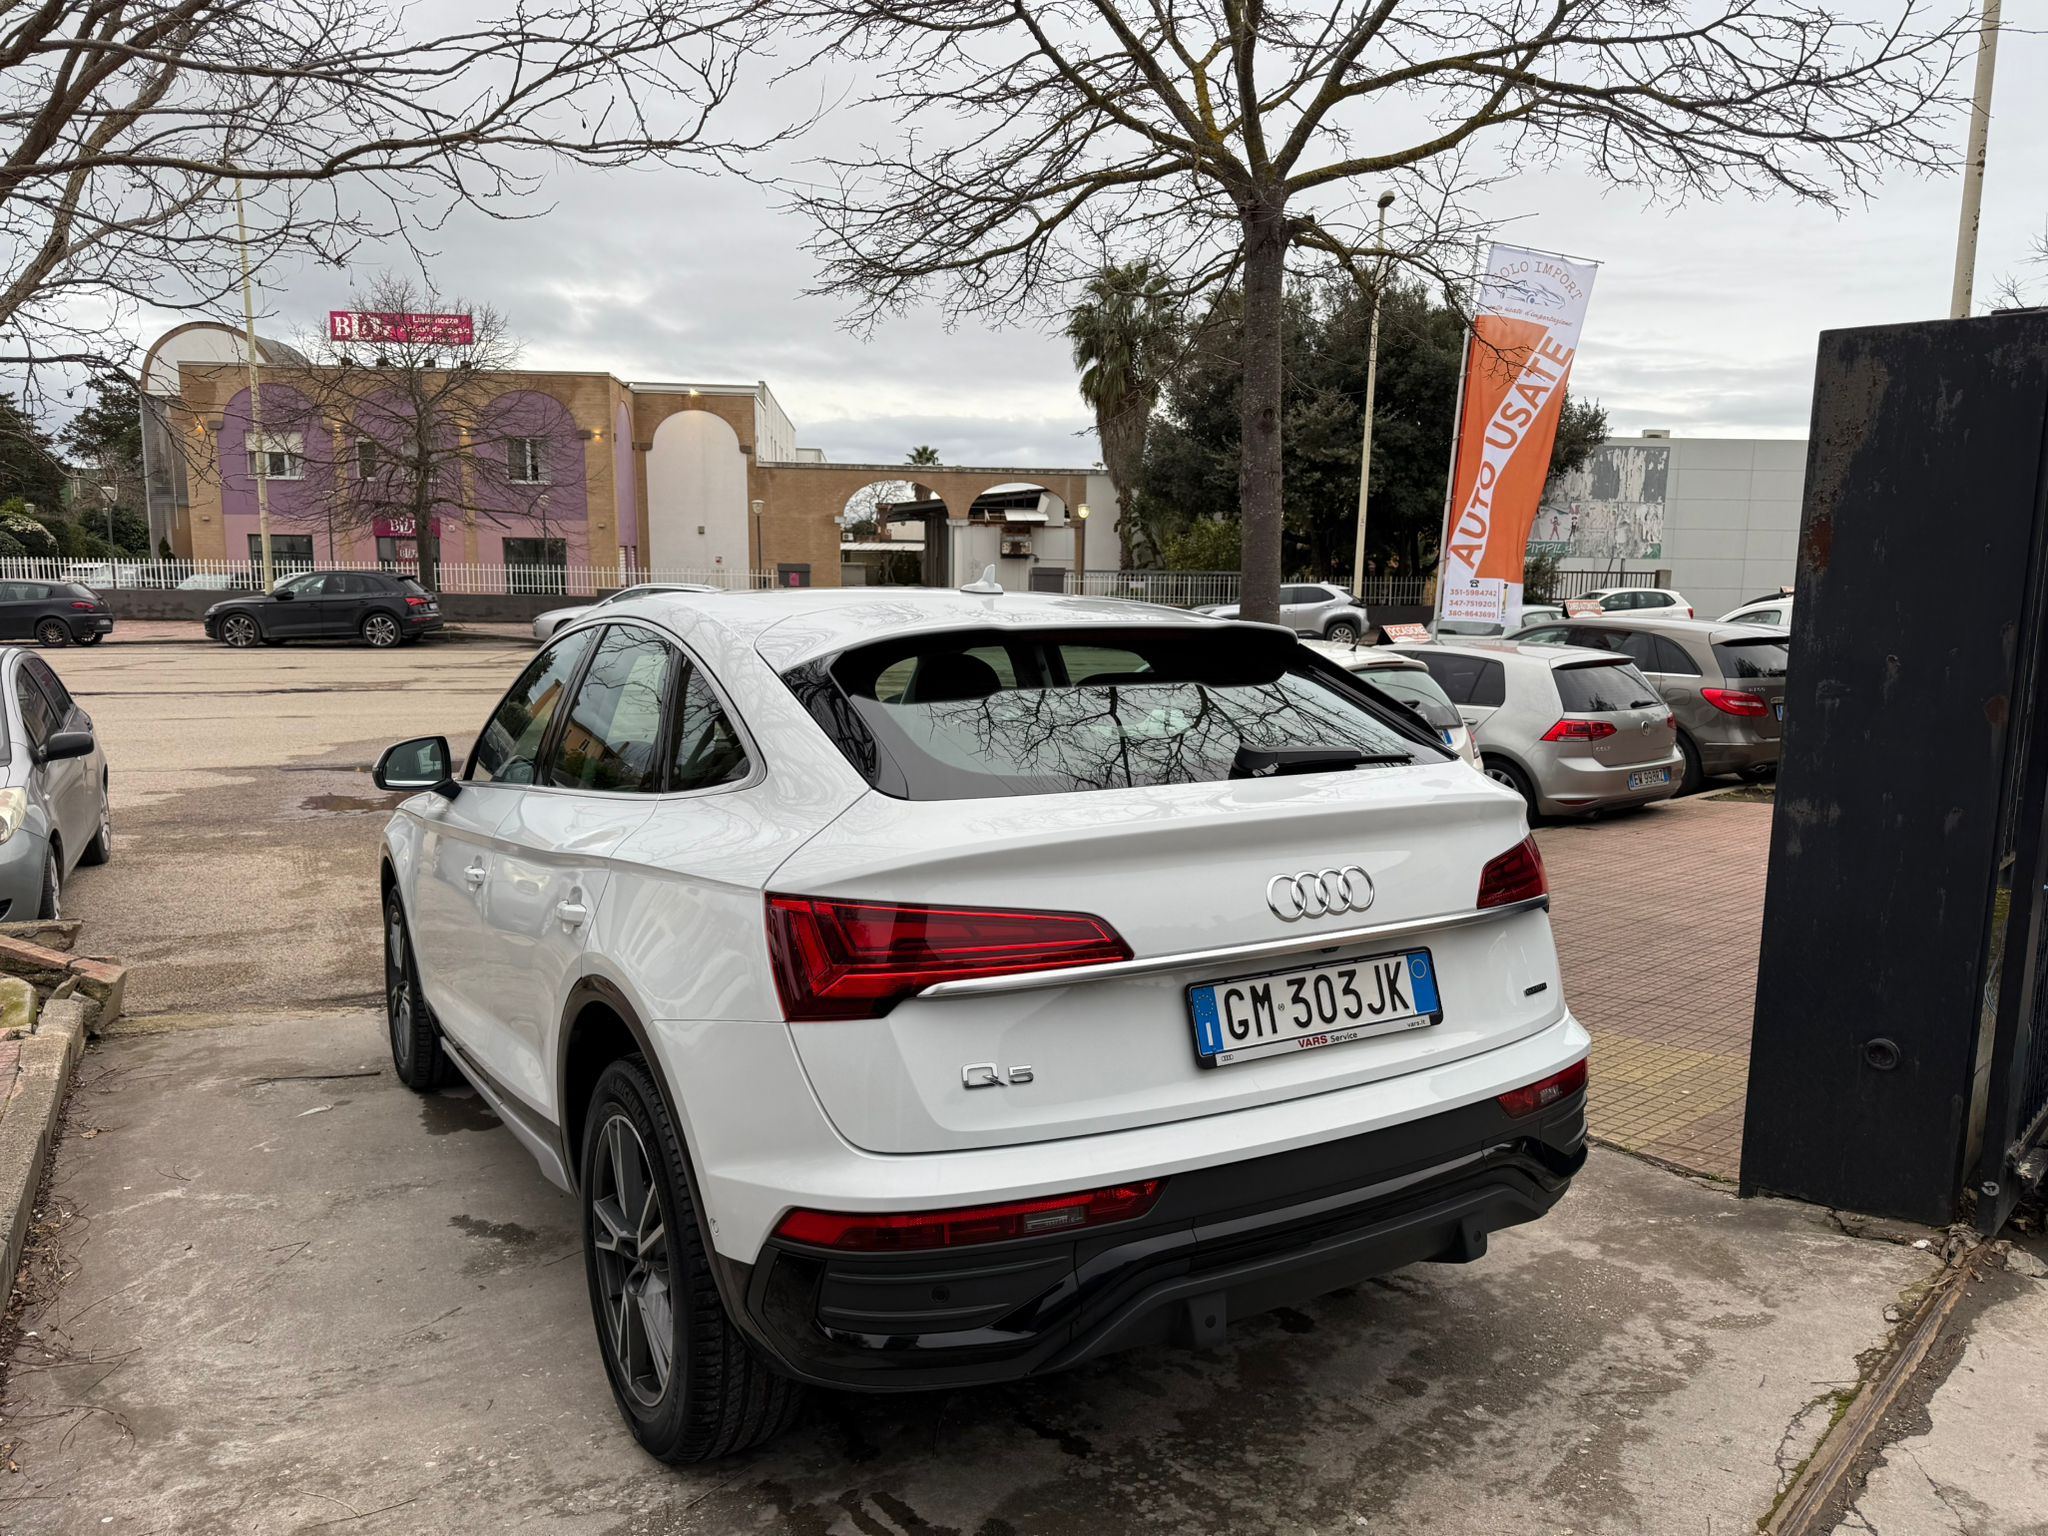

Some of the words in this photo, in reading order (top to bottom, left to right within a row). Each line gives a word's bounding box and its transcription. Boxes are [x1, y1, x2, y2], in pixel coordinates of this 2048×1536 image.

[1534, 261, 1583, 300] IMPORT
[1450, 460, 1497, 570] AUTO
[1485, 336, 1575, 450] USATE
[1223, 982, 1278, 1040] GM
[1286, 960, 1410, 1029] 303JK
[1297, 1034, 1328, 1049] VARS
[1330, 1032, 1358, 1044] Service
[1406, 1018, 1426, 1029] vars.it
